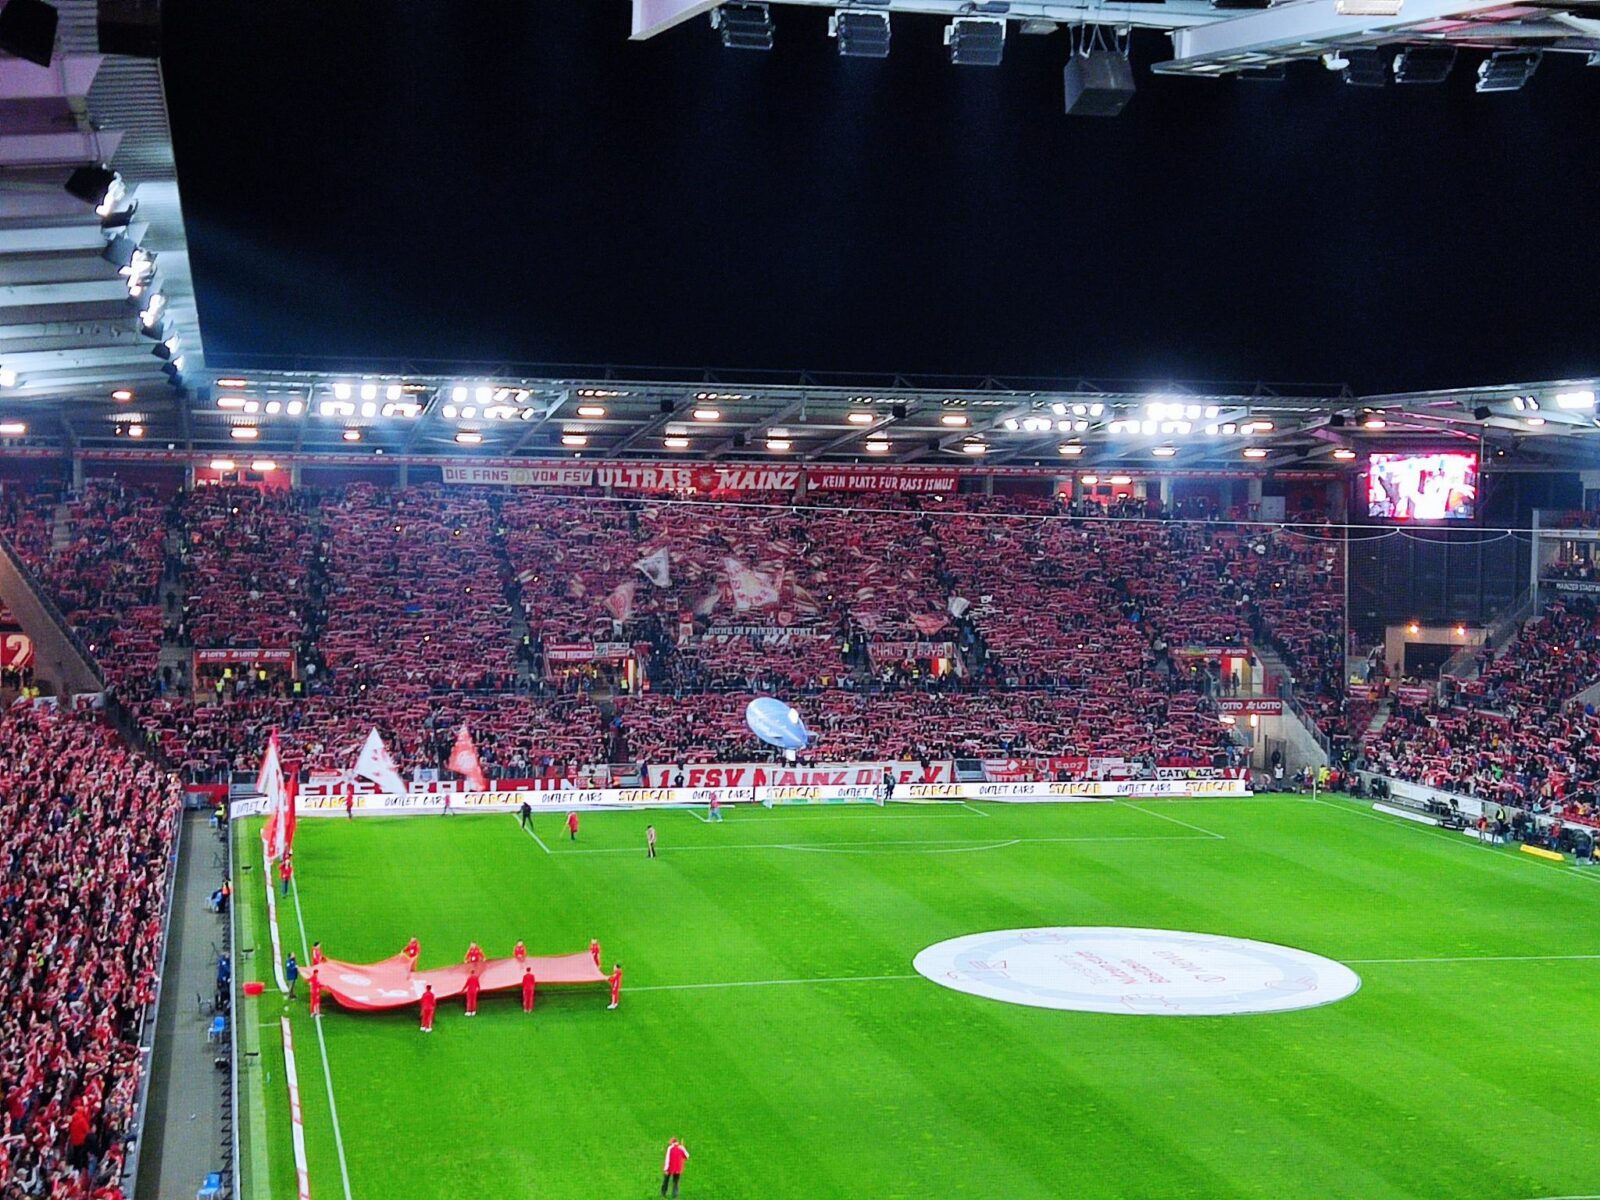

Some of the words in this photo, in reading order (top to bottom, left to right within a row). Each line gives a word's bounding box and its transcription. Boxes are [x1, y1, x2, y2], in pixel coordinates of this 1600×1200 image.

[445, 469, 467, 480] DIE
[473, 470, 509, 481] FANS
[532, 471, 558, 482] VOM
[563, 471, 591, 482] FSV
[597, 468, 692, 488] ULTRAS
[717, 470, 801, 490] MAINZ
[822, 475, 845, 488] KEIN
[849, 476, 877, 489] PLATZ
[1256, 701, 1282, 710] LOTTO
[688, 768, 746, 788] FSV
[752, 767, 848, 787] MAINZ
[980, 785, 1008, 795] OUTLET
[1012, 785, 1035, 794] CARS
[1150, 783, 1171, 792] CARS
[542, 793, 574, 803] OUTLET
[579, 792, 602, 803] CARS
[727, 789, 750, 799] CARS
[423, 796, 446, 805] CAR
